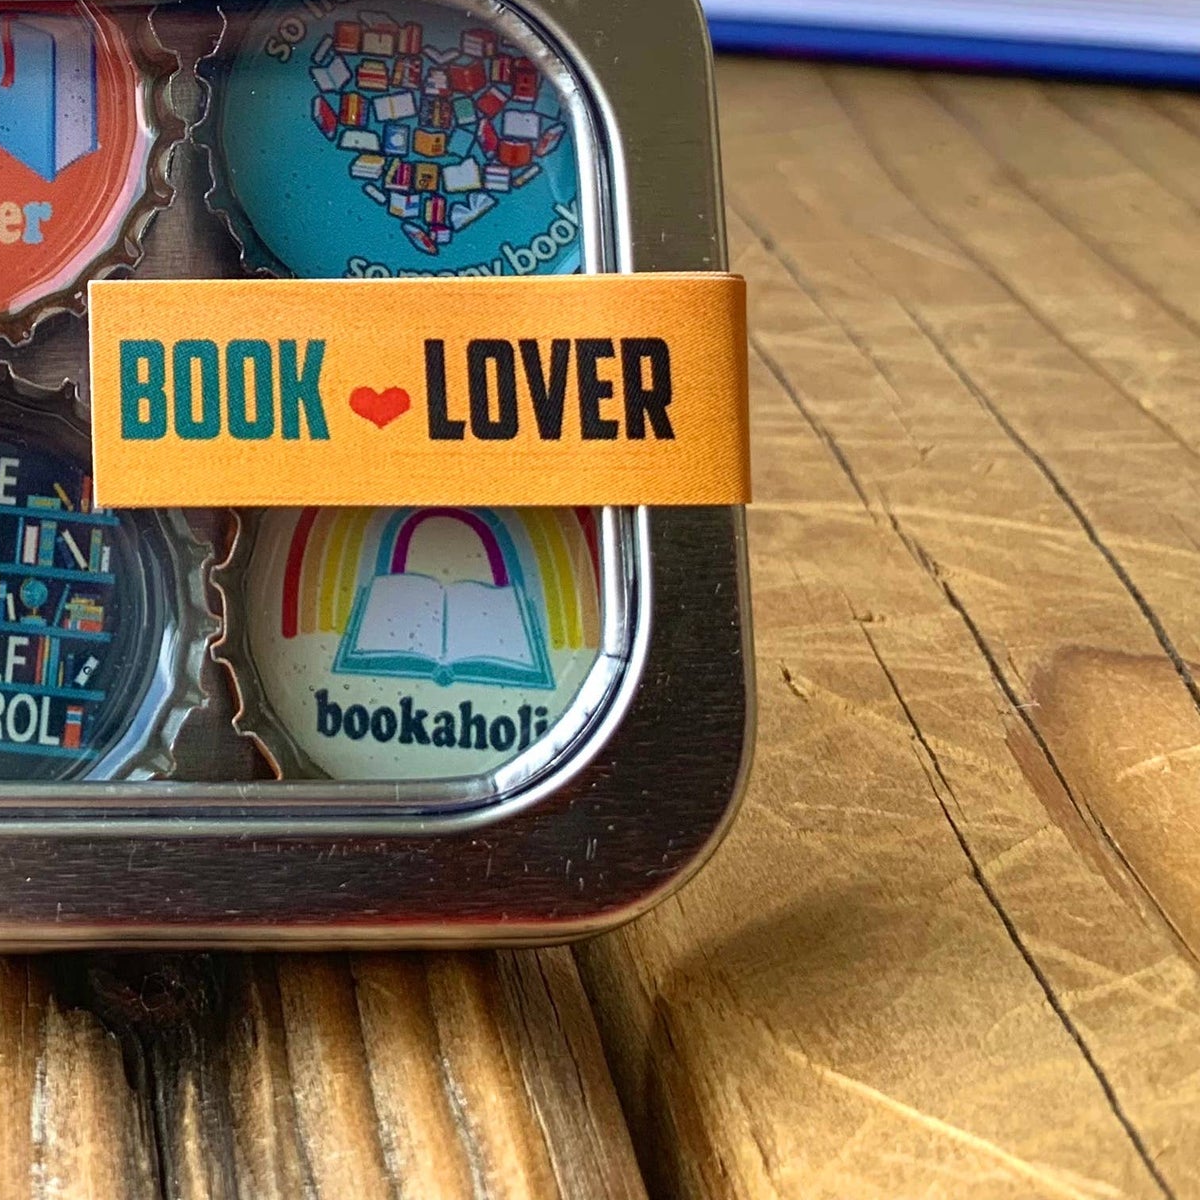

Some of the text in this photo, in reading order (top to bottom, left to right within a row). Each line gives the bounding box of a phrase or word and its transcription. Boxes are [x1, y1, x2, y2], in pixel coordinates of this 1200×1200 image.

[265, 16, 306, 63] so
[119, 338, 676, 442] BOOK LOVER
